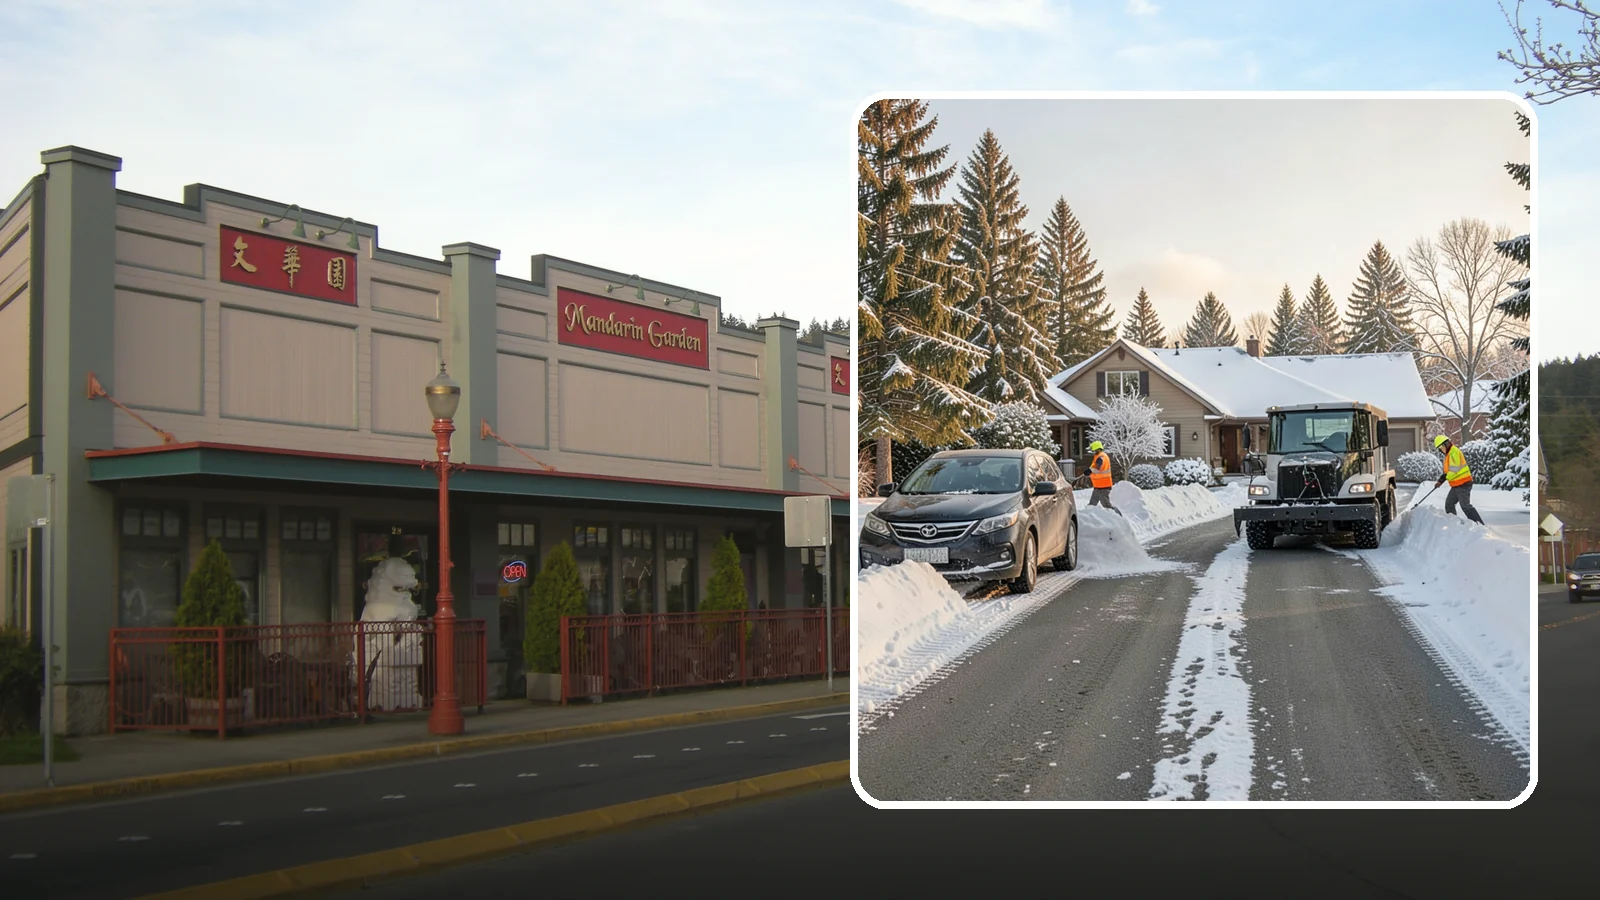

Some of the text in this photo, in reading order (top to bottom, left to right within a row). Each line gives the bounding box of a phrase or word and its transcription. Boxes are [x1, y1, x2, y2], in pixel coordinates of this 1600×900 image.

[231, 236, 346, 290] 文華園
[564, 302, 701, 352] Mandarin Garden
[503, 565, 527, 578] OPEN
